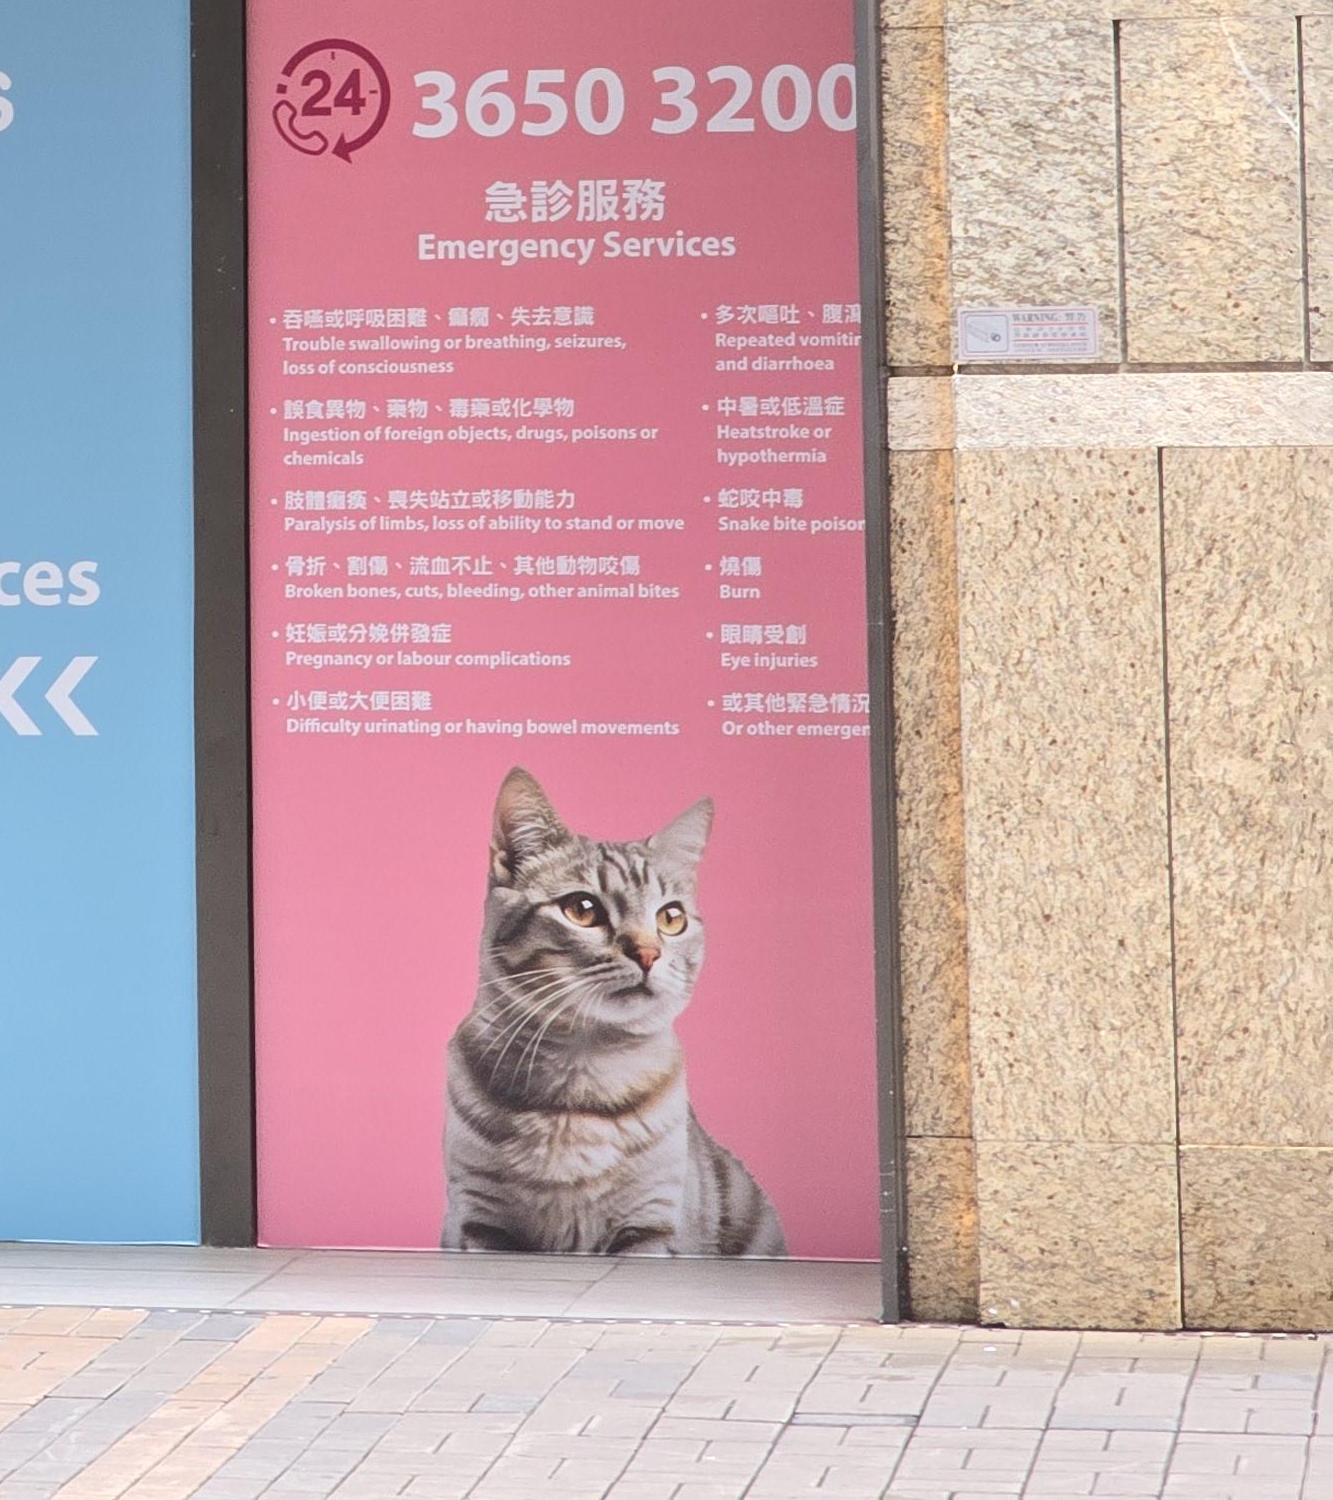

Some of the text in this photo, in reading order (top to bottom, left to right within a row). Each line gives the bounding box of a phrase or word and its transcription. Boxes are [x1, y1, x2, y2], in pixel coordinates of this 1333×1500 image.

[300, 68, 366, 117] 24
[411, 63, 857, 139] 3650 3200
[484, 178, 666, 223] 急診服務
[418, 229, 736, 267] Emergency Services
[281, 333, 627, 354] Trouble swallowing or breathing, seizures,
[715, 331, 796, 351] Repeated
[283, 359, 454, 375] loss of consciousness
[715, 355, 835, 372] and diarrhoea
[717, 395, 846, 417] 中暑或低溫症
[283, 425, 659, 446] Ingestion of foreign objects, drugs, poisons or
[716, 423, 832, 439] Heatstroke or
[283, 450, 364, 466] chemicals
[716, 447, 827, 467] hypothermia
[717, 487, 804, 509] 蛇咬中毒
[284, 514, 685, 535] Paralysis of limbs, loss of ability to stand or move
[718, 515, 771, 531] Snake
[773, 515, 808, 532] bite
[719, 555, 762, 577] 燒傷
[284, 582, 680, 602] Broken bones, cuts, bleeding, other animal bites
[719, 584, 761, 599] Burn
[285, 622, 452, 644] 妊娠或分娩併發症
[720, 623, 807, 645] 眼睛受創
[285, 650, 571, 670] Pregnancy or labour complications
[720, 652, 819, 671] Eye injuries
[286, 690, 432, 711] 小便或大便困難
[286, 717, 680, 738] Difficulty urinating or having bowel movements
[721, 720, 744, 736] Or
[746, 720, 794, 736] other
